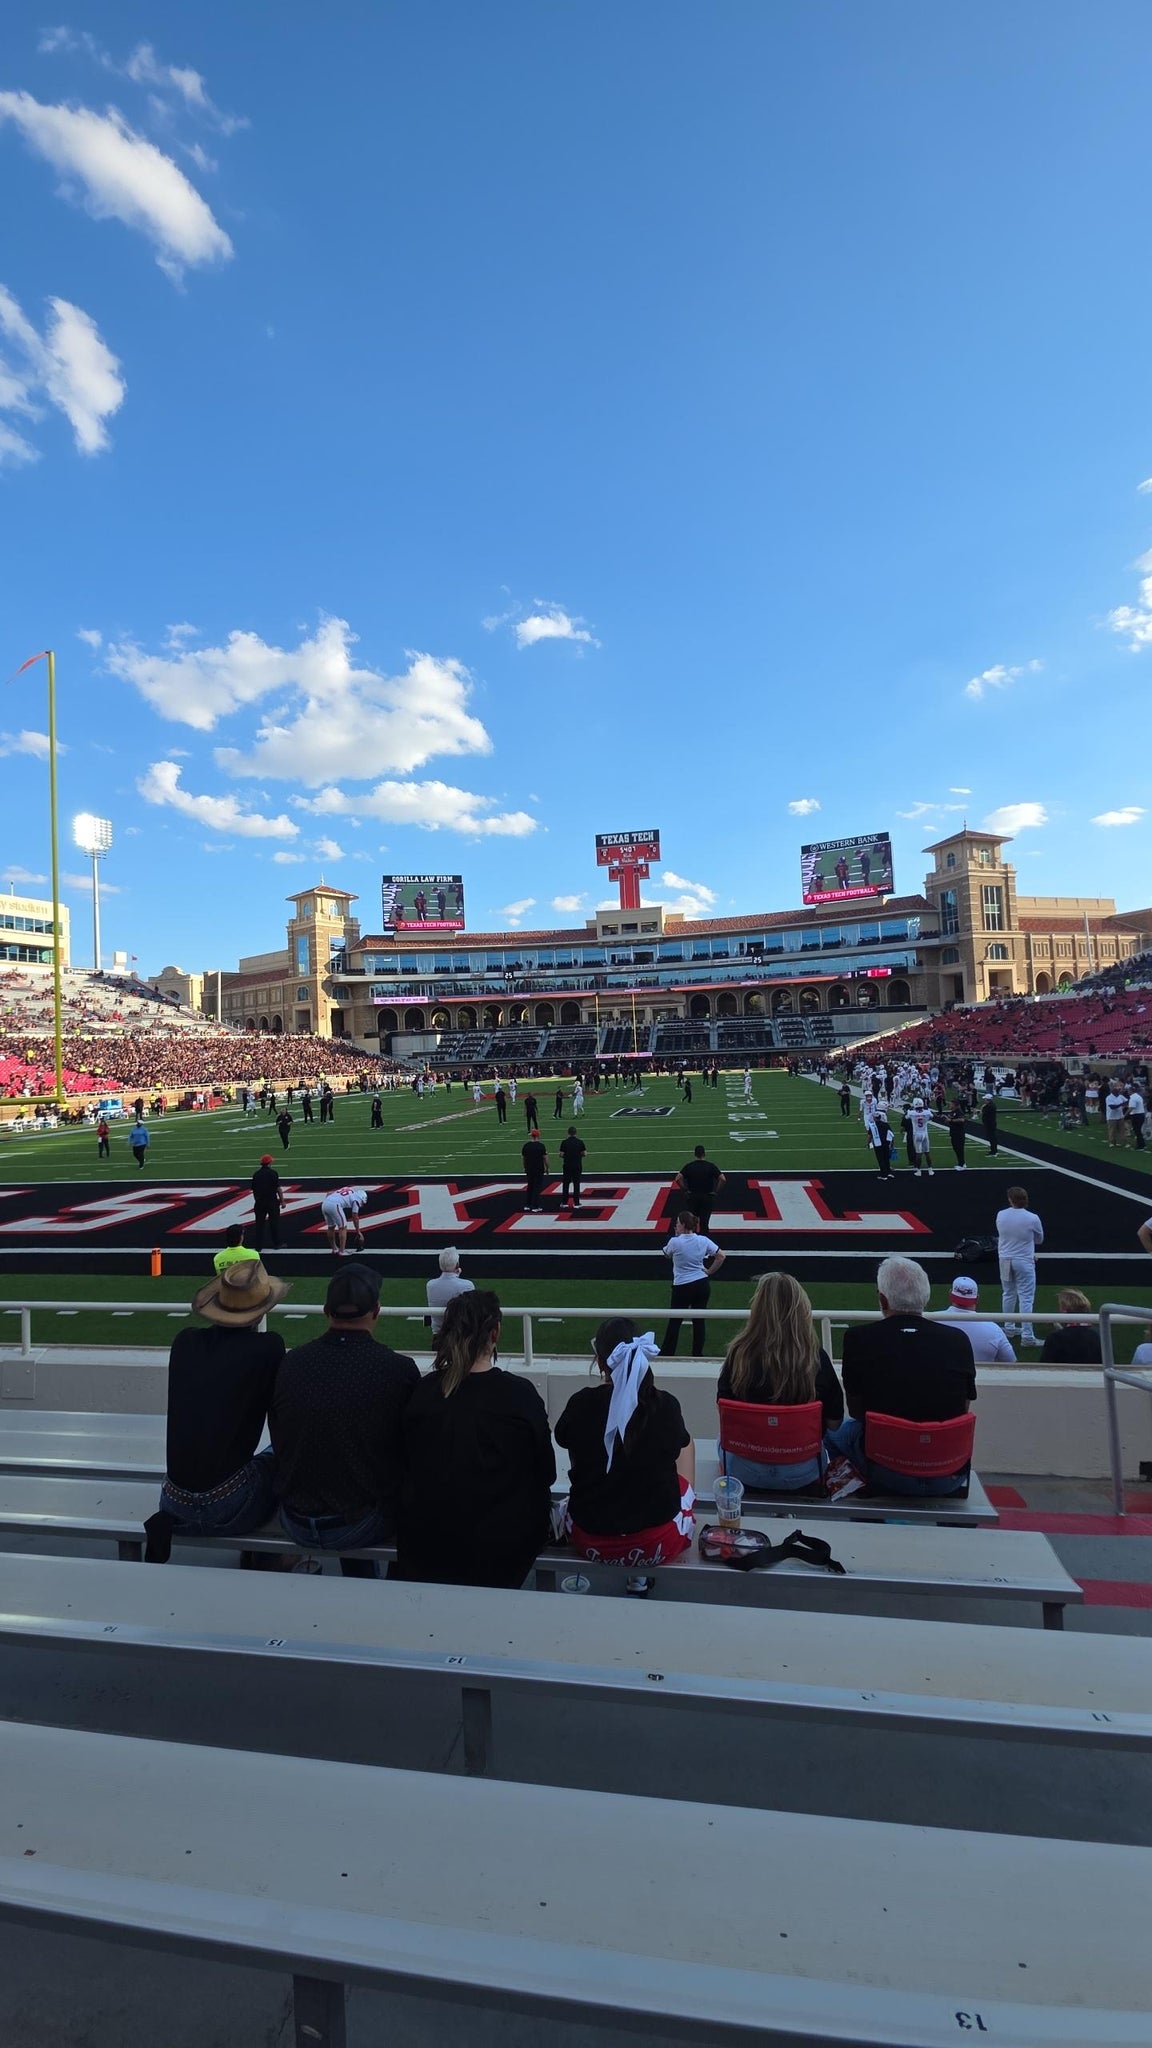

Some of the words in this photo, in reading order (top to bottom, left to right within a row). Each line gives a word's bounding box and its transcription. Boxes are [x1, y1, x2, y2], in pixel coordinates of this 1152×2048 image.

[601, 834, 629, 845] TEXAS
[632, 832, 653, 842] TECH
[820, 840, 855, 851] WESTERN
[857, 835, 878, 844] BANK
[813, 892, 831, 900] TEXAS
[847, 885, 875, 895] FOOTBALL
[753, 956, 762, 964] 25
[586, 1548, 624, 1567] Txas
[628, 1543, 666, 1568] Tech
[268, 1639, 283, 1647] 15
[955, 2011, 988, 2031] 13
